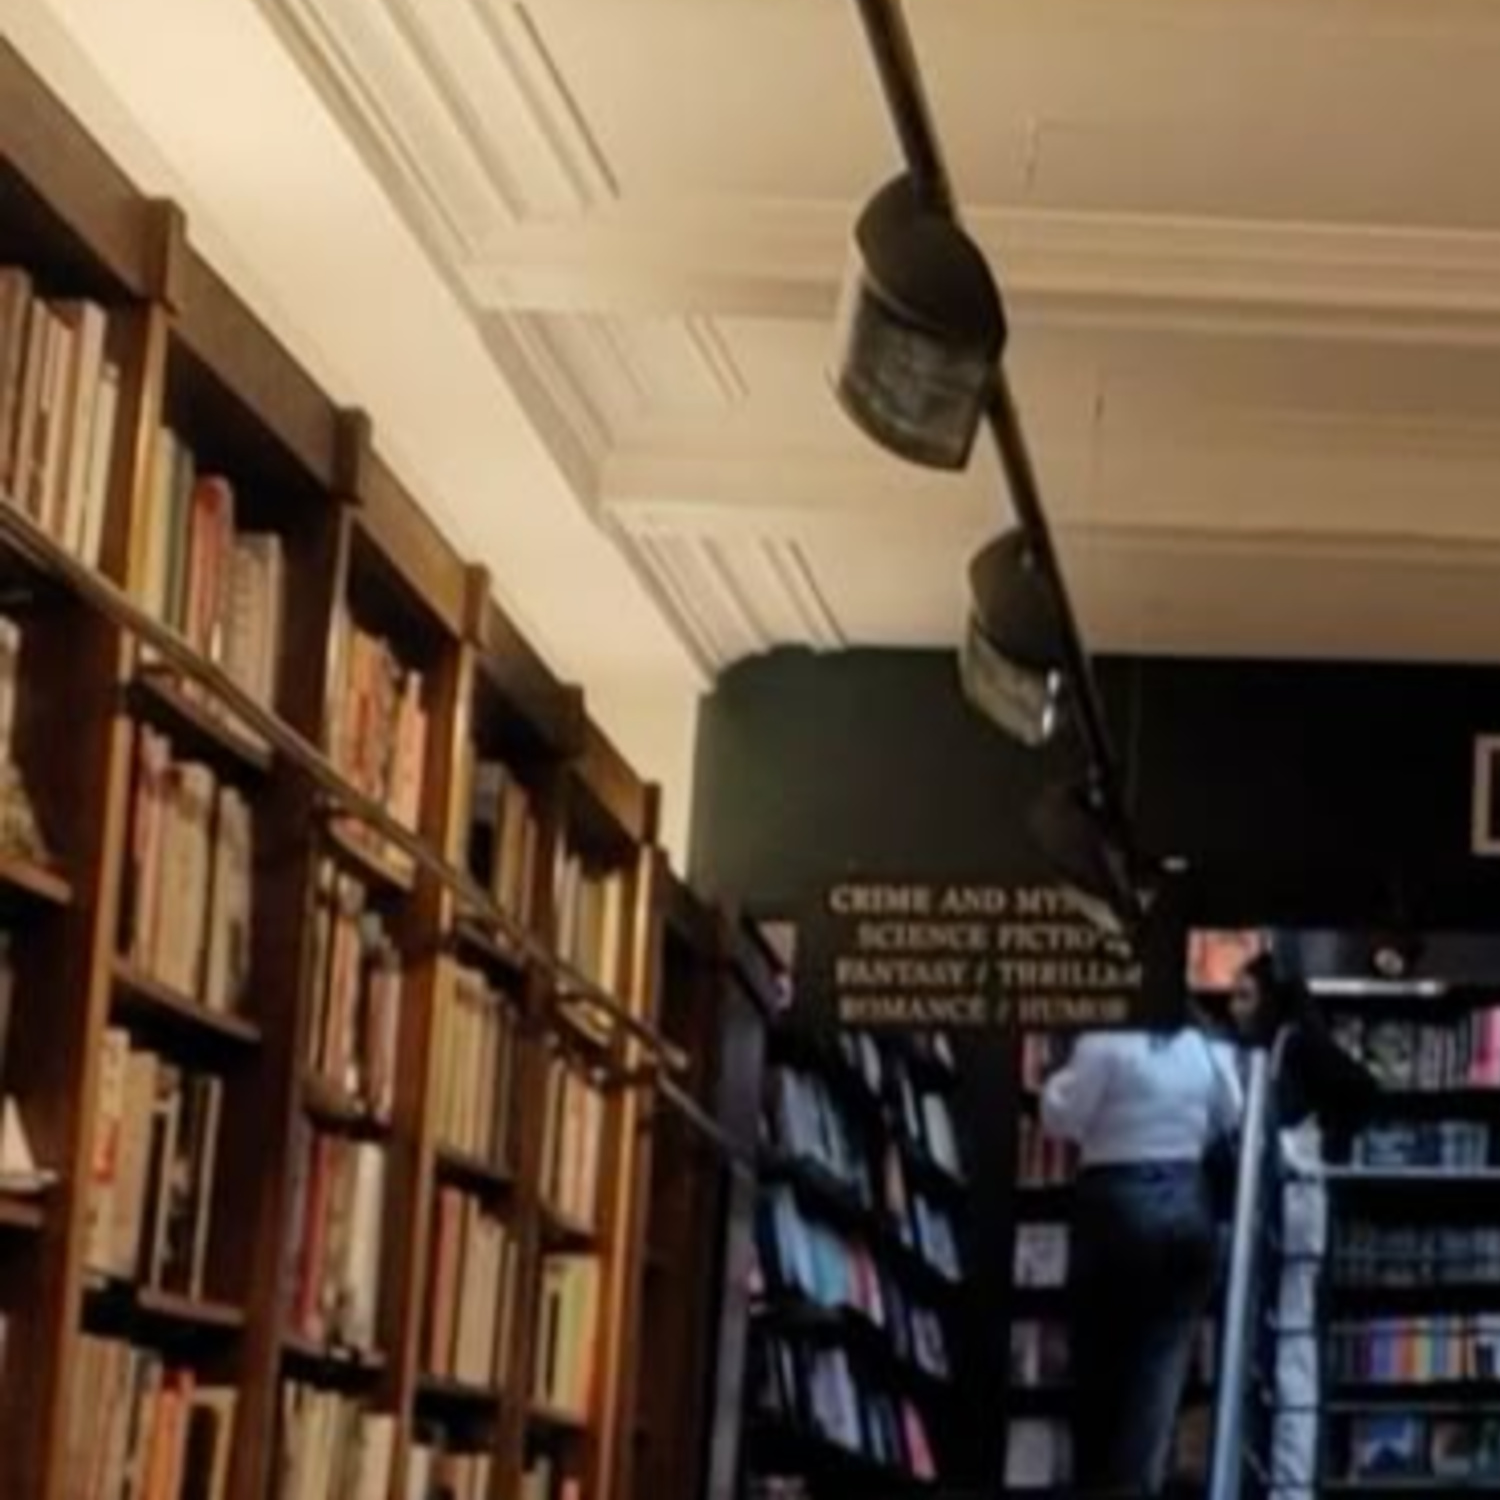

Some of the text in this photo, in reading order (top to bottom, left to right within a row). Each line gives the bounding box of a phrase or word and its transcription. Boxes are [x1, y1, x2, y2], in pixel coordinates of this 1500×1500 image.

[830, 886, 930, 914] CRIME
[941, 886, 1005, 914] AND
[858, 923, 1124, 951] SCIENCE FICTIO
[836, 957, 966, 986] FANTASY
[840, 997, 985, 1023] ROMANCE
